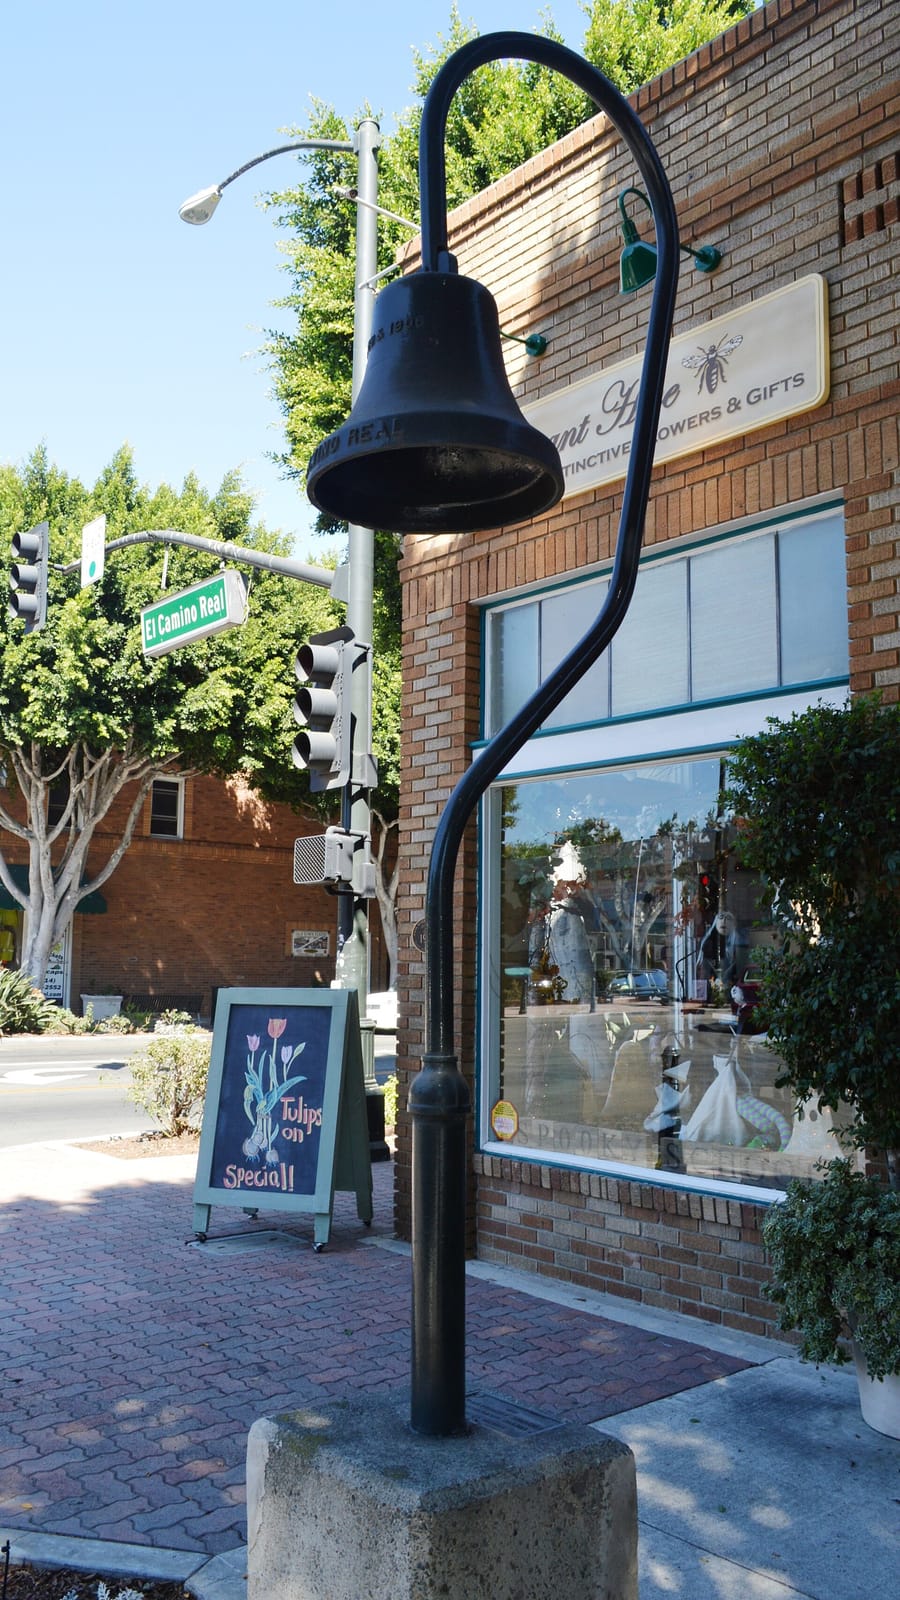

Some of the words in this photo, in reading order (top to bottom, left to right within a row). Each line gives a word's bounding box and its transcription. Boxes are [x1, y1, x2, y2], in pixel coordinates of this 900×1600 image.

[551, 414, 591, 453] ant
[562, 440, 632, 479] TINCTIVE
[656, 405, 722, 443] OWERS
[726, 396, 742, 414] &
[746, 372, 805, 406] GIFTS
[145, 618, 156, 641] El
[157, 604, 198, 636] Camino
[199, 588, 224, 617] Real
[280, 1096, 323, 1134] Tulips
[281, 1127, 304, 1143] on
[223, 1162, 295, 1192] Special!
